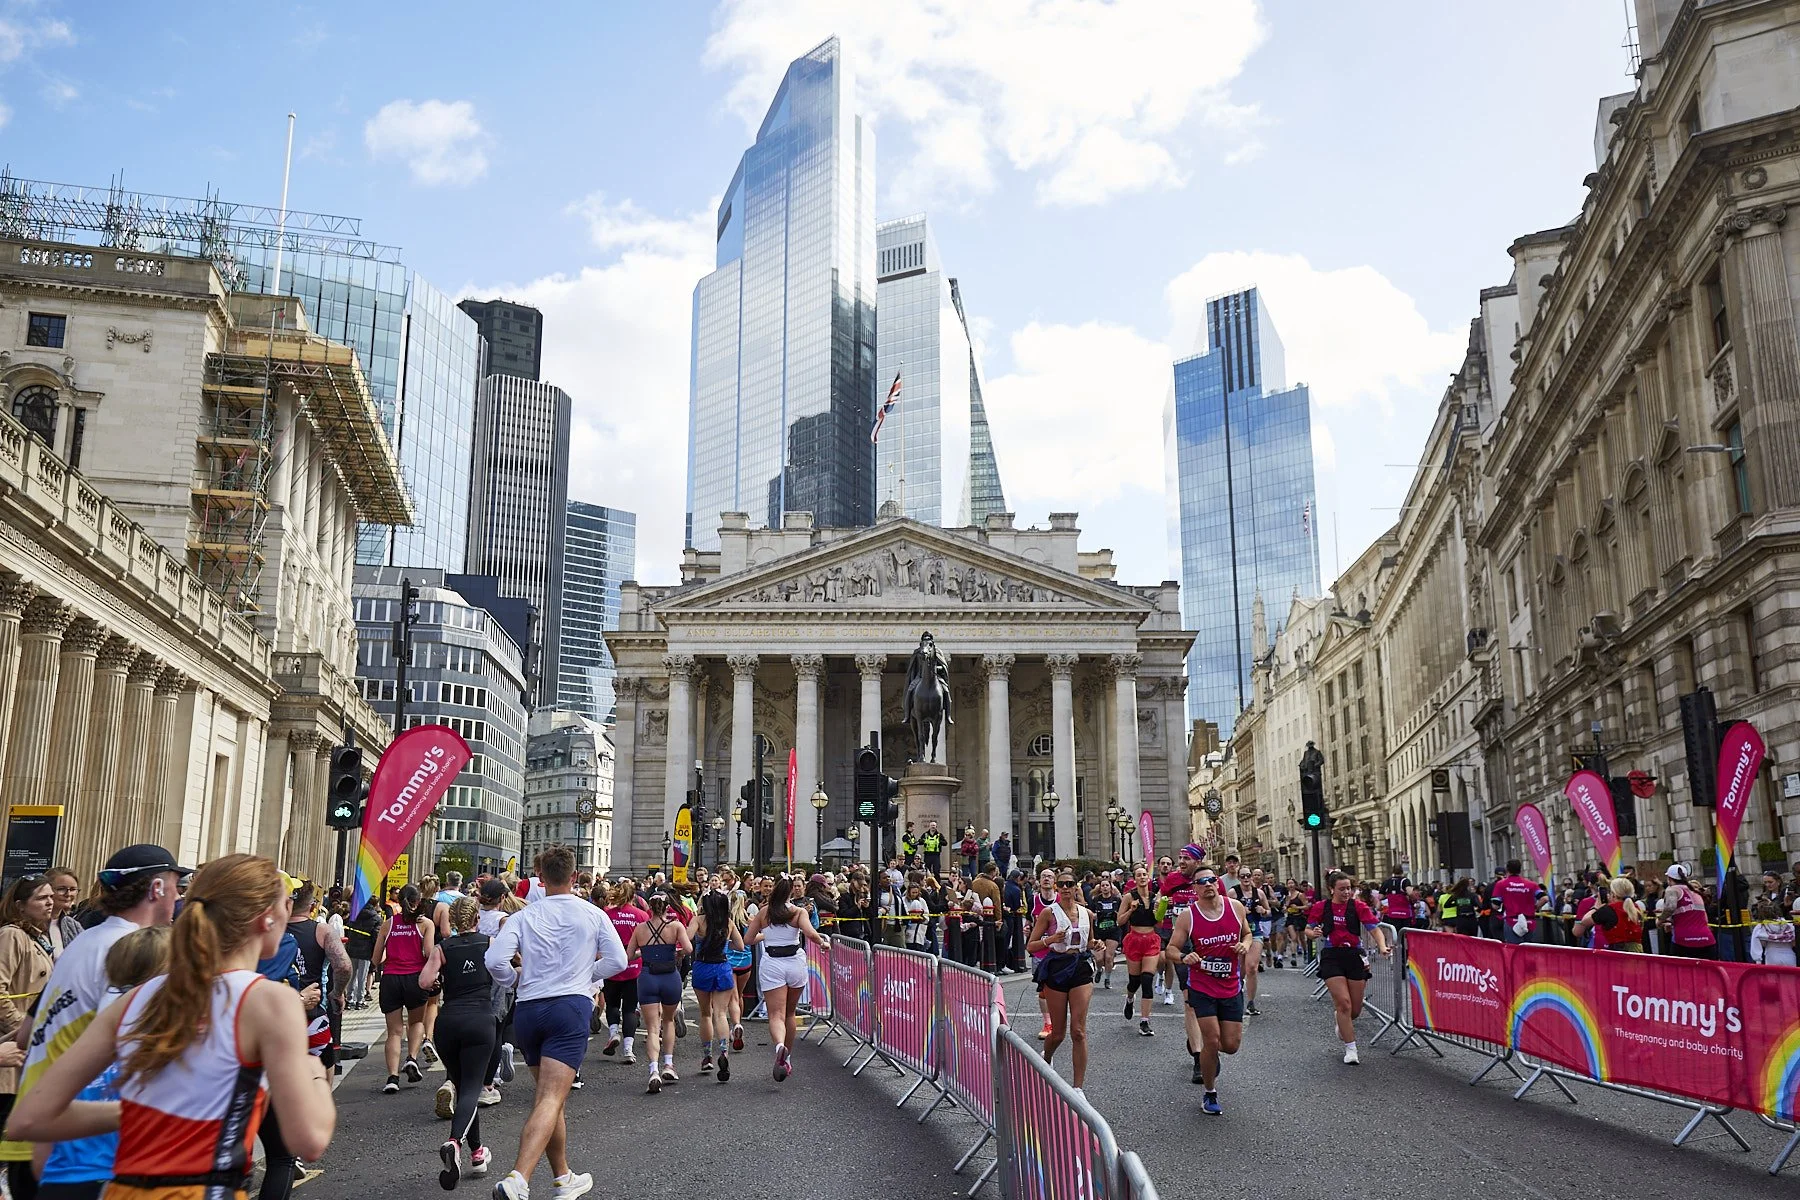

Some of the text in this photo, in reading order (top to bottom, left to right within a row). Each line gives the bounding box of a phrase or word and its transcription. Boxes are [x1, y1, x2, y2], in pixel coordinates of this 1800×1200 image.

[377, 745, 445, 824] Tommy's
[397, 754, 456, 832] The pregnancy and baby charity
[1722, 741, 1752, 810] Tommy's
[617, 911, 636, 919] Team
[1198, 932, 1238, 946] Tommy's
[1203, 961, 1231, 971] 11920
[1436, 957, 1499, 993] Tommy's
[1611, 984, 1742, 1038] Tommy's
[1669, 1038, 1685, 1049] and
[1686, 1039, 1709, 1055] baby
[1710, 1043, 1744, 1061] charity
